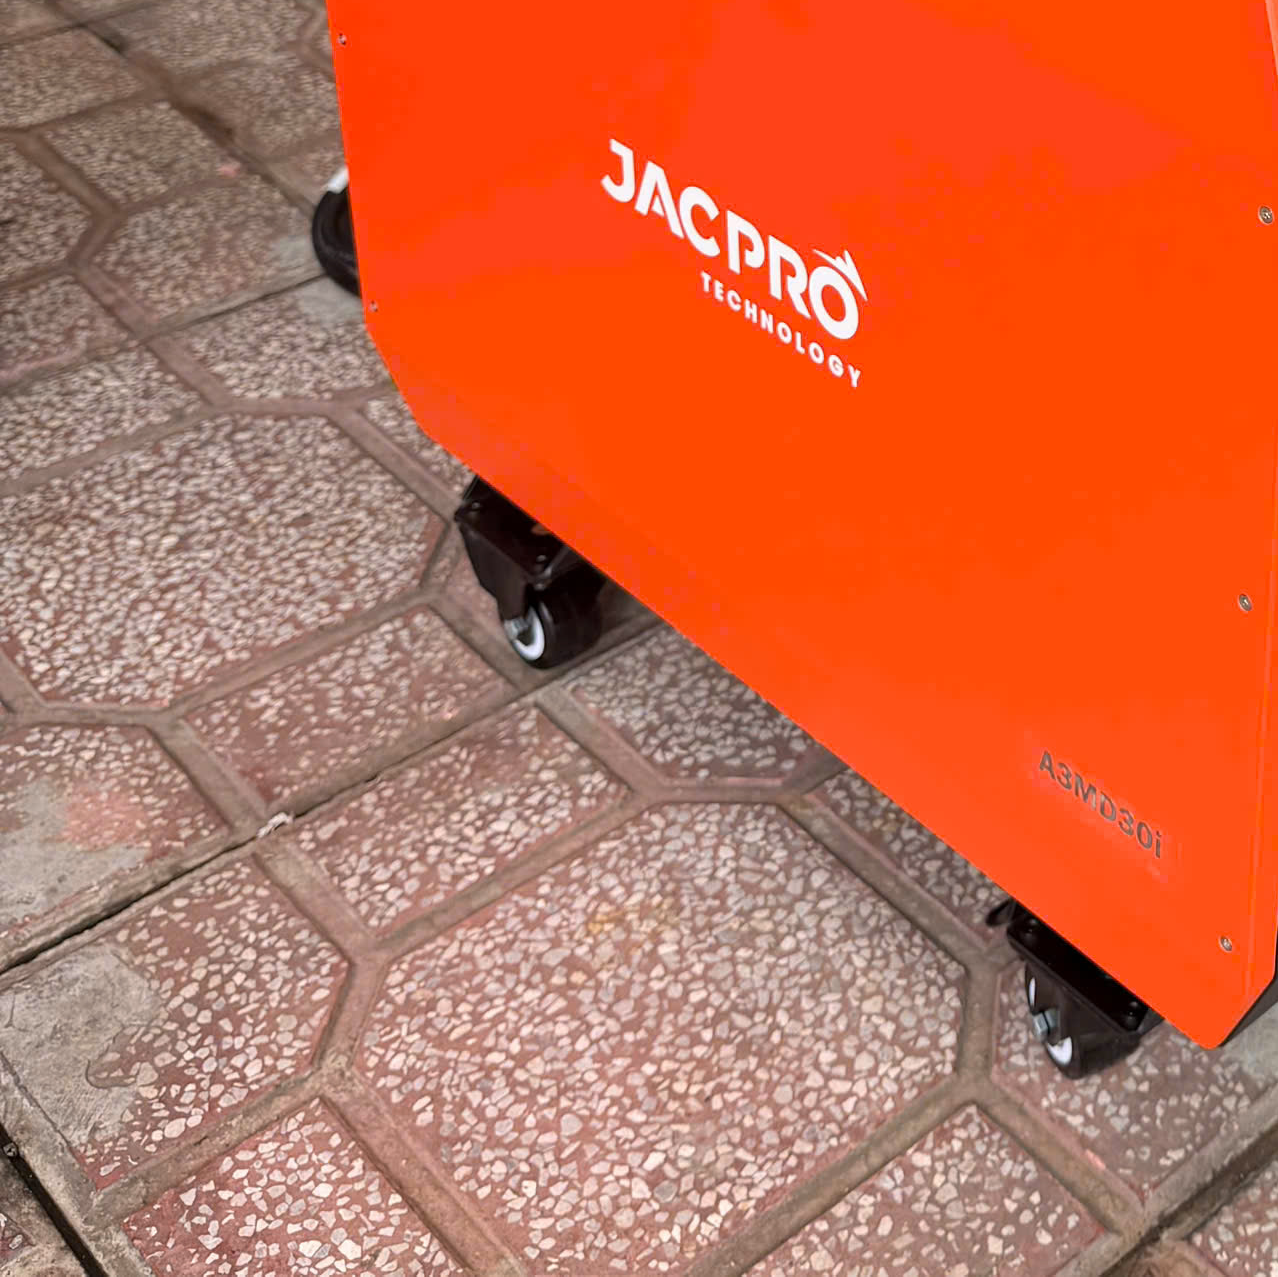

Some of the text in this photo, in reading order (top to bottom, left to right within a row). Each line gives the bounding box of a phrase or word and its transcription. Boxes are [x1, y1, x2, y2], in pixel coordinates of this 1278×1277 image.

[601, 138, 860, 340] JACPRO
[701, 270, 861, 388] TECHNOLOGY
[1039, 750, 1162, 858] A3MD30i
